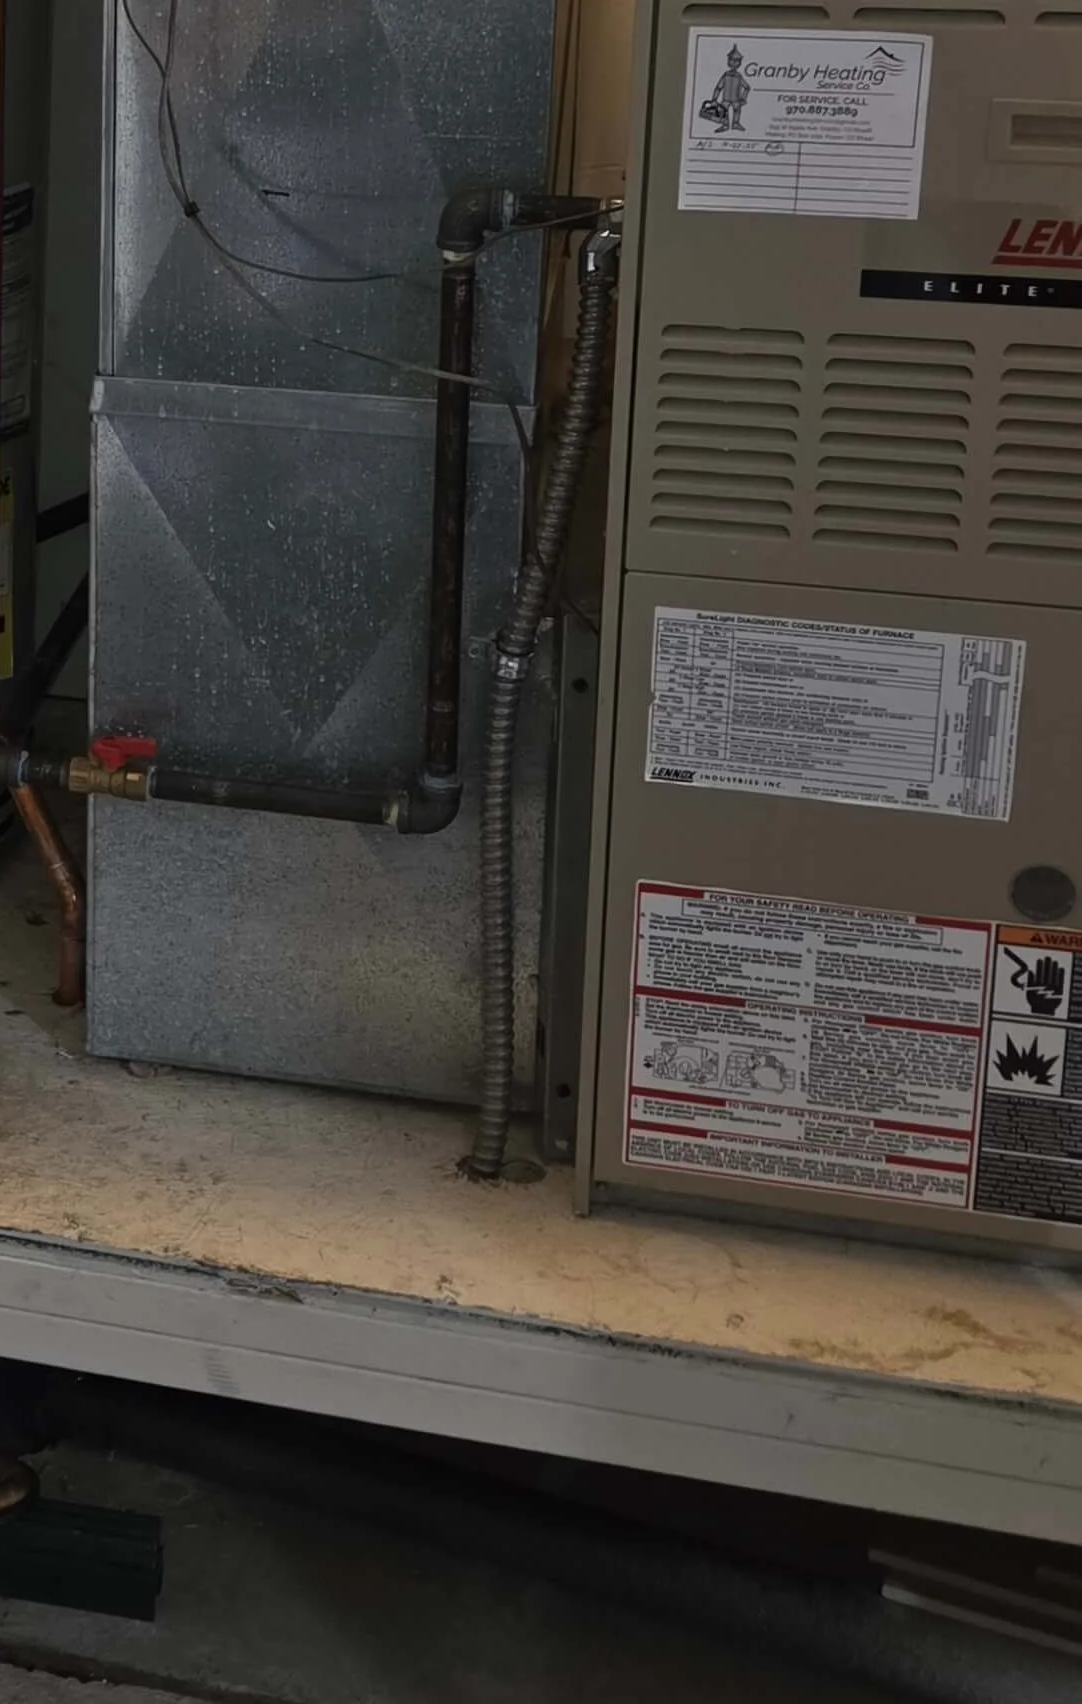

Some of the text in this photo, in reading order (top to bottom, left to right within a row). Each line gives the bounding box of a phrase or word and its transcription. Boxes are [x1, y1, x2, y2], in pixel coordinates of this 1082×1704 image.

[744, 62, 885, 89] Granby Heating
[816, 80, 855, 91] Service
[777, 94, 797, 103] FOR
[842, 97, 869, 106] CALL
[923, 280, 1039, 297] ELITE
[736, 615, 789, 628] DIAGNOSTIC
[858, 627, 869, 635] OF
[871, 628, 915, 640] FURNACE
[651, 767, 696, 782] LENNOX
[700, 774, 760, 787] INDUSTRIES
[709, 893, 728, 902] FOR
[730, 896, 754, 905] YOUR
[756, 899, 790, 909] SAFETY
[747, 1003, 796, 1015] OPERATING
